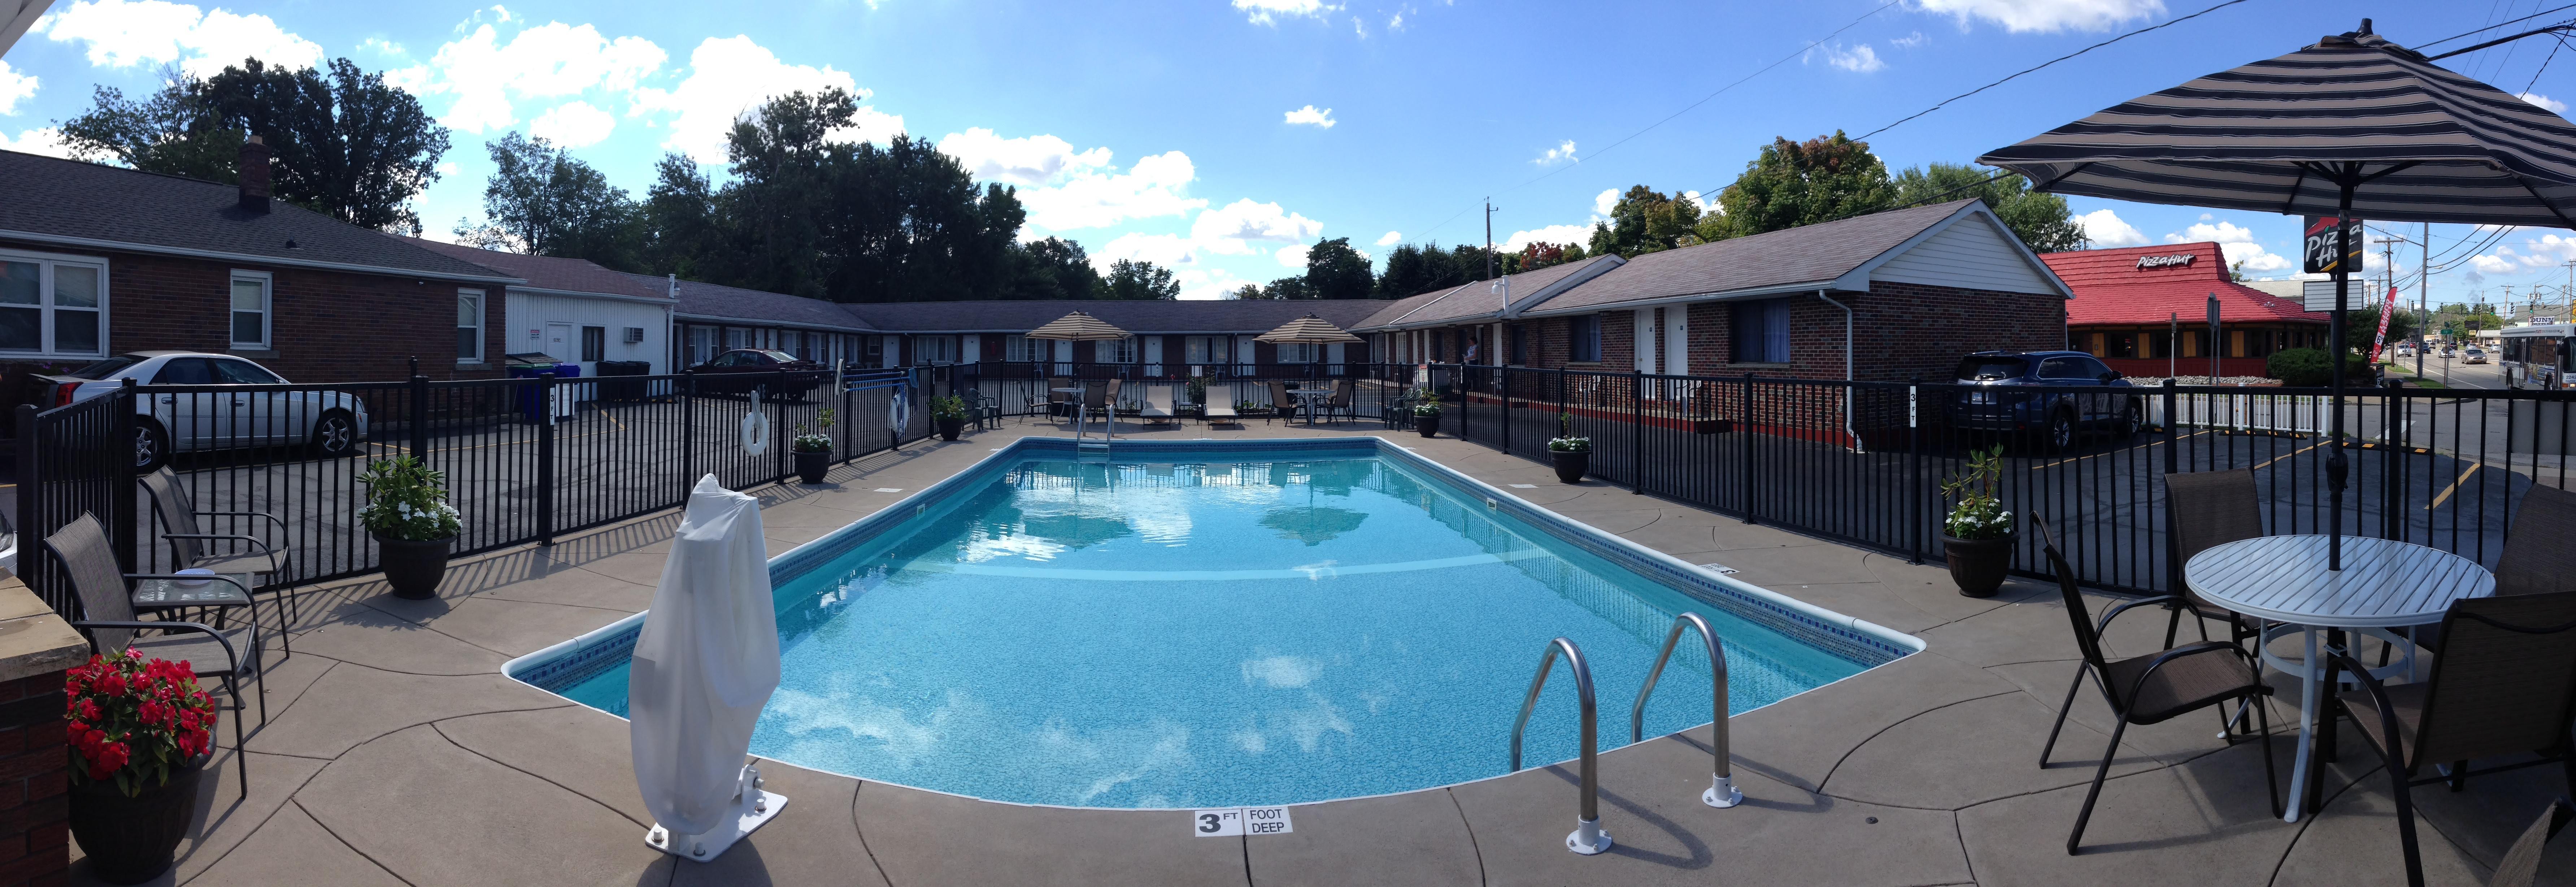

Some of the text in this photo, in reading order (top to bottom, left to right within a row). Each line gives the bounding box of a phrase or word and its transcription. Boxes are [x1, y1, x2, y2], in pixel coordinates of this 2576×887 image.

[2306, 225, 2362, 262] Piza
[2380, 298, 2390, 331] BUFFET
[2382, 300, 2393, 333] LUNCH
[1199, 813, 1221, 833] 3
[1250, 809, 1282, 819] FOOT
[1252, 822, 1284, 833] DEEP
